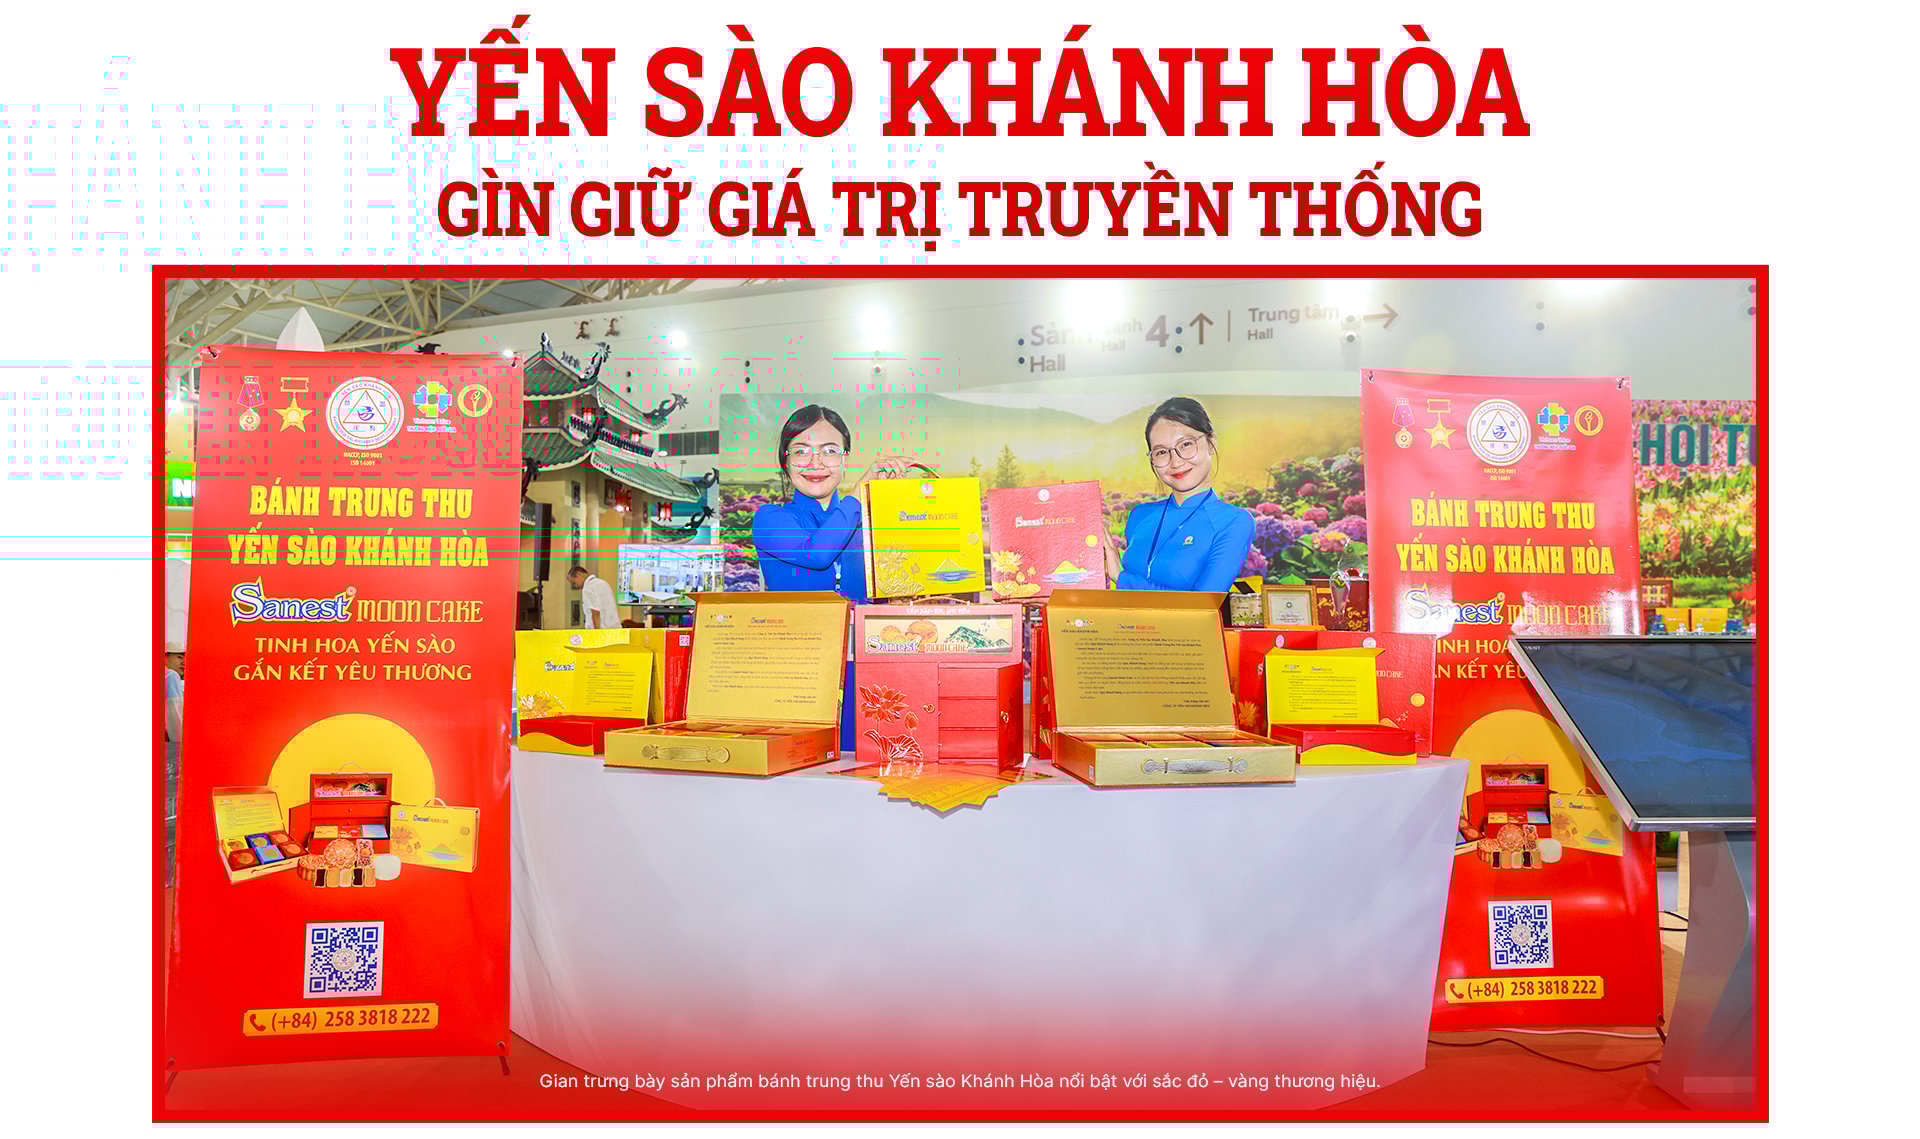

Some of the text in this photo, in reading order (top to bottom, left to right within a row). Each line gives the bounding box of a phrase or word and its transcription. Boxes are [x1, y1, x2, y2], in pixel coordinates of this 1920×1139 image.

[1248, 303, 1339, 324] Trung tâm
[1145, 314, 1170, 348] 4
[1247, 328, 1274, 341] Hall
[1102, 339, 1126, 352] Hall
[1030, 355, 1067, 373] Hall
[361, 451, 370, 459] ISO
[1641, 415, 1710, 478] HỘI
[172, 478, 196, 498] N
[250, 476, 473, 519] BÁNH TRUNG THU
[1411, 491, 1596, 529] BÁNH TRUNG THU
[228, 522, 489, 567] YẾN SÀO KHÁNH HÒA
[1396, 531, 1616, 575] YẾN SÀO KHÁNH HÒA
[229, 576, 484, 628] Sanest MOON CAKE
[1507, 604, 1561, 625] MOON
[255, 630, 456, 654] TINH HOA YẾN SÀO
[867, 634, 921, 655] Sanest
[1437, 639, 1470, 654] INH
[233, 657, 473, 681] GẮN KẾT YÊU THƯƠNG
[1456, 657, 1488, 679] KẾT
[1467, 979, 1597, 1000] (+84) 258 3818 222
[271, 1007, 430, 1032] (+84) 258 3818 222
